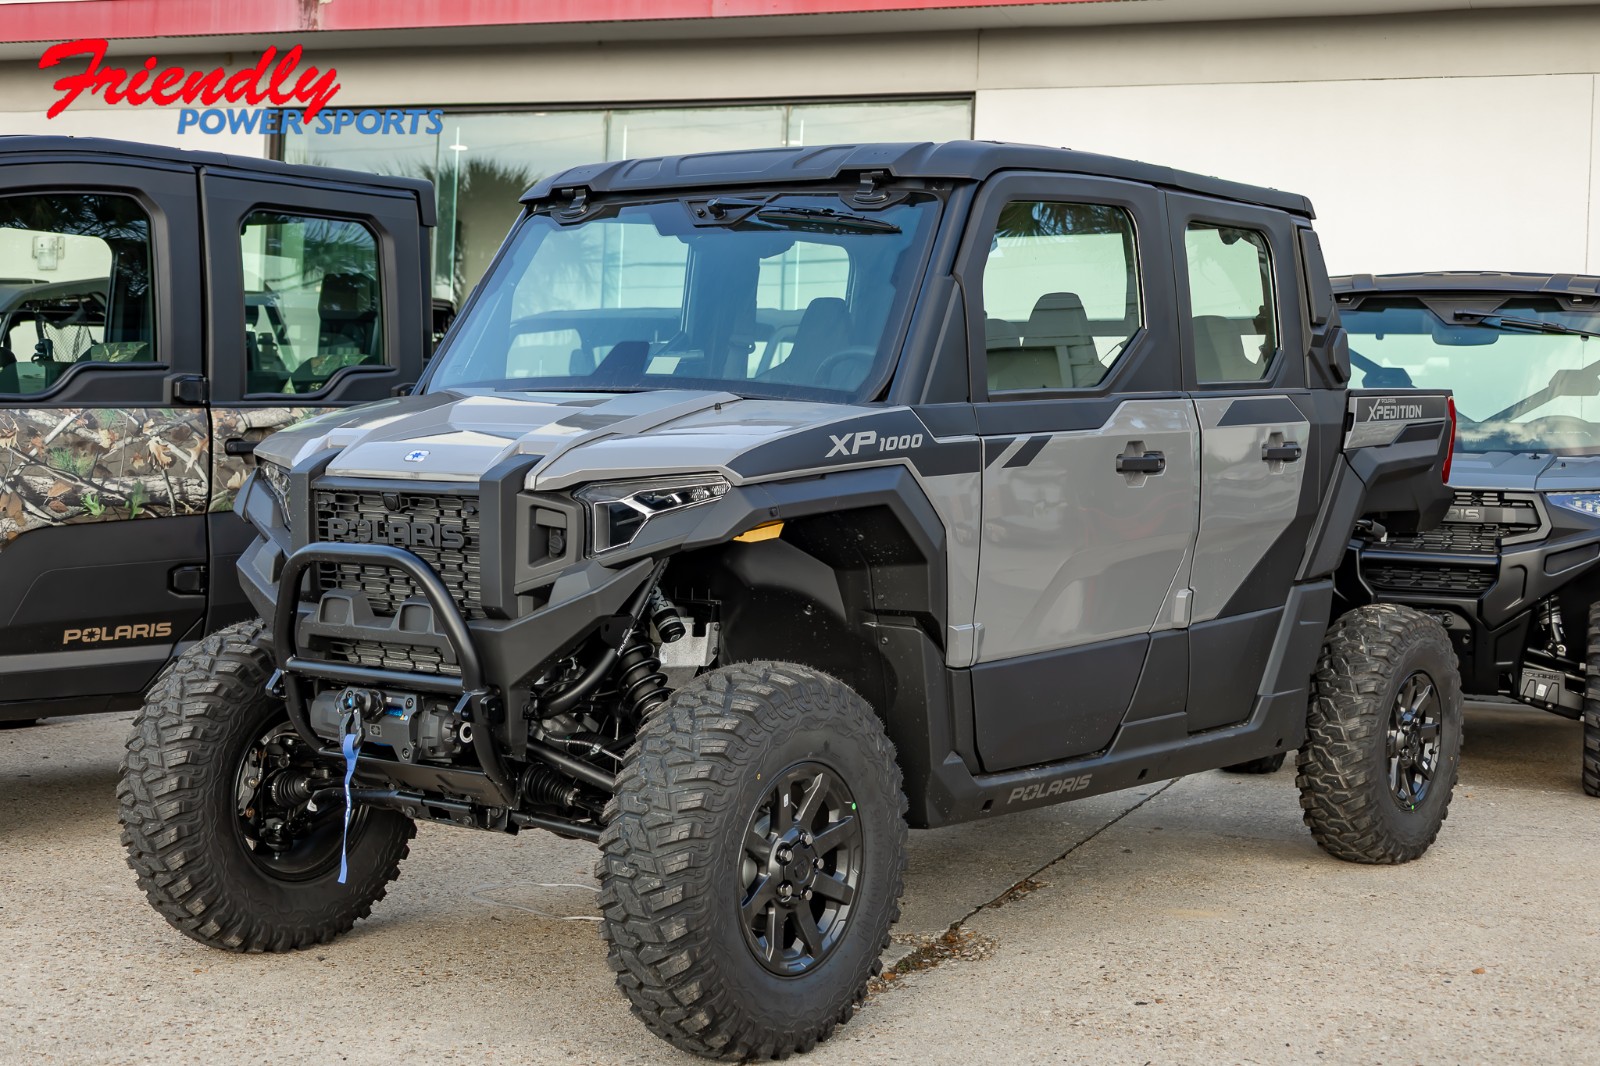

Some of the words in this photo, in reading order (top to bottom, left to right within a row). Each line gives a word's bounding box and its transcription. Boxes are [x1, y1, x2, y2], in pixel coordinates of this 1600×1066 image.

[1367, 398, 1422, 422] XPEDITION
[825, 430, 877, 458] XP
[879, 433, 923, 452] 1000
[327, 517, 465, 549] POLARIS
[63, 622, 172, 645] POLARIS
[1007, 773, 1093, 805] POLARIS
